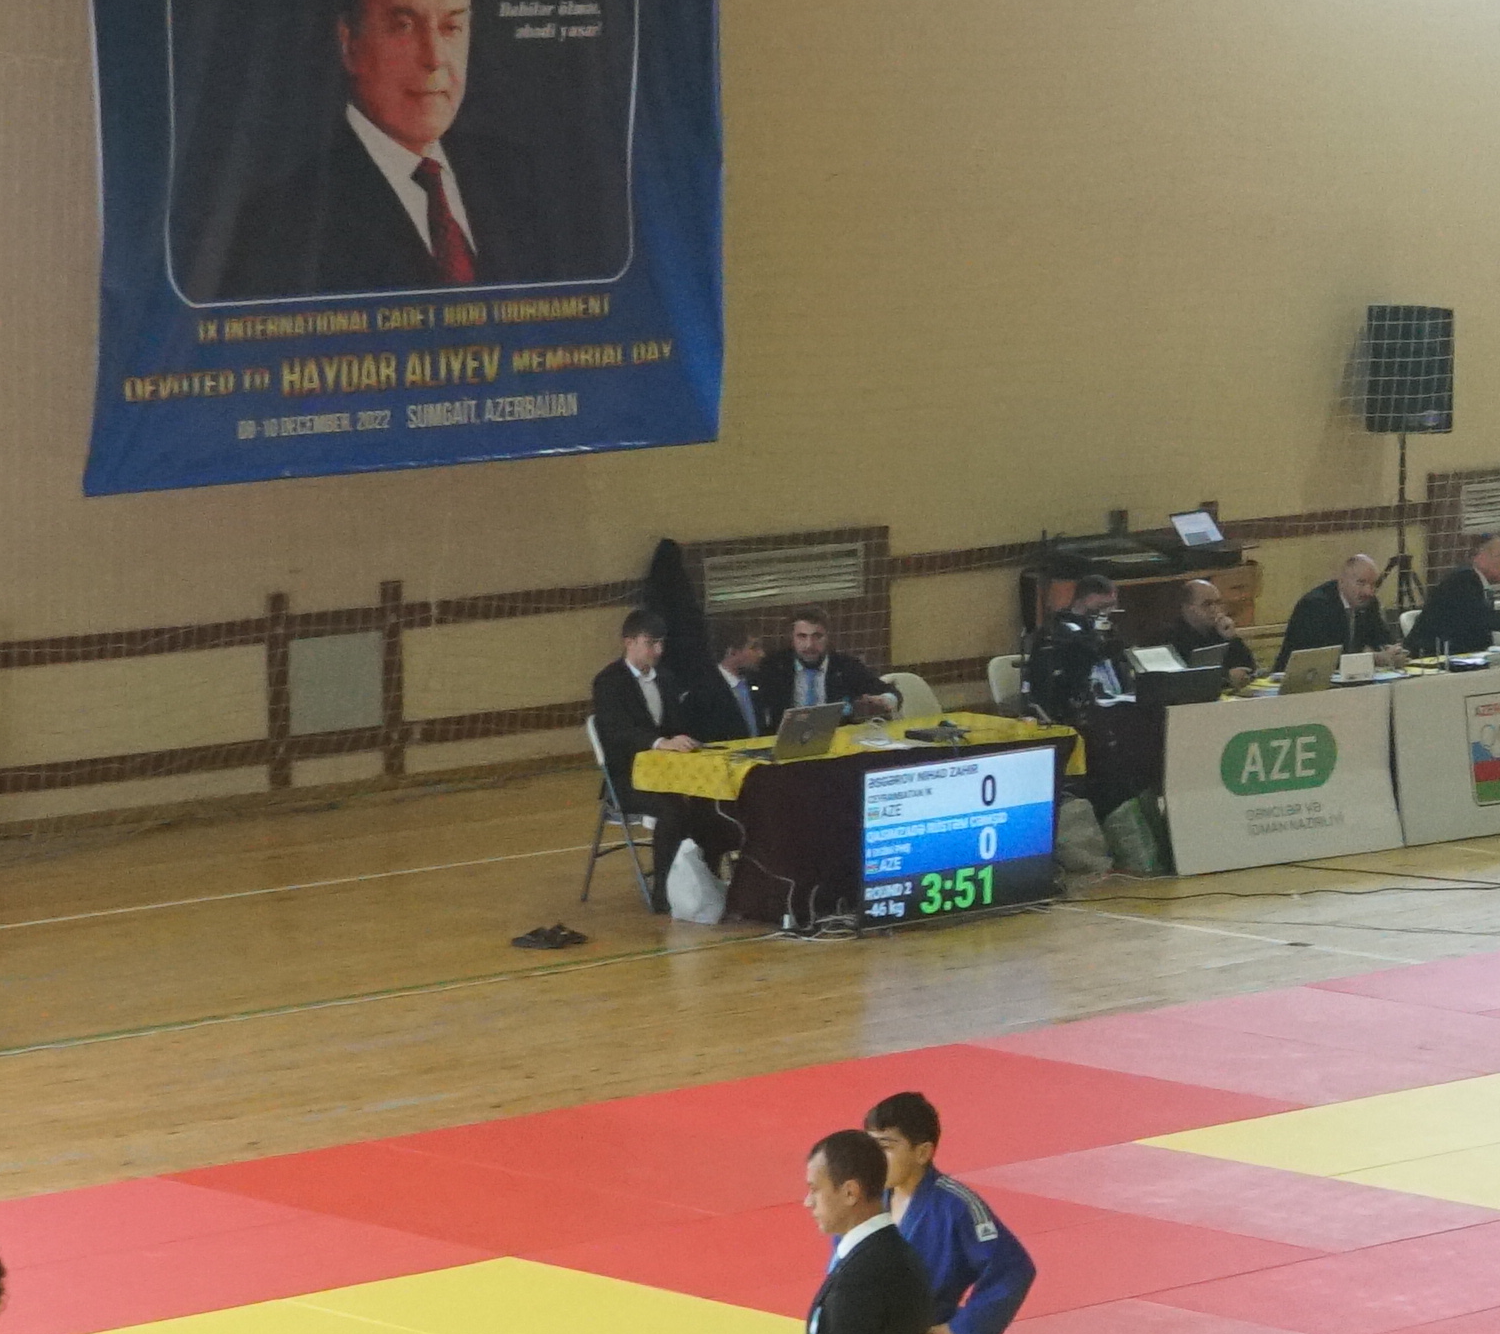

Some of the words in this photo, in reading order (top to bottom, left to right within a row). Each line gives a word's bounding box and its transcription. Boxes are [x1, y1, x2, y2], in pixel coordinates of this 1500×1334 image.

[199, 319, 217, 343] IX
[224, 309, 369, 341] INTERNATIONAL
[377, 304, 437, 331] CADET
[443, 302, 487, 326] JUDO
[493, 293, 610, 324] TOURNAMENT
[124, 369, 235, 402] DEVOTED
[242, 368, 270, 392] TO
[282, 352, 397, 397] HAYDAR
[405, 345, 501, 388] ALIYEV
[512, 343, 624, 373] MEMORIAL
[632, 339, 672, 364] DAY
[357, 410, 391, 430] 2022
[1240, 735, 1318, 784] AZE
[981, 774, 996, 806] 0
[881, 803, 902, 817] AZE
[979, 826, 997, 860] 0
[865, 883, 903, 901] ROUND
[903, 881, 912, 895] 2
[919, 865, 994, 915] 3:51
[887, 899, 906, 917] kg
